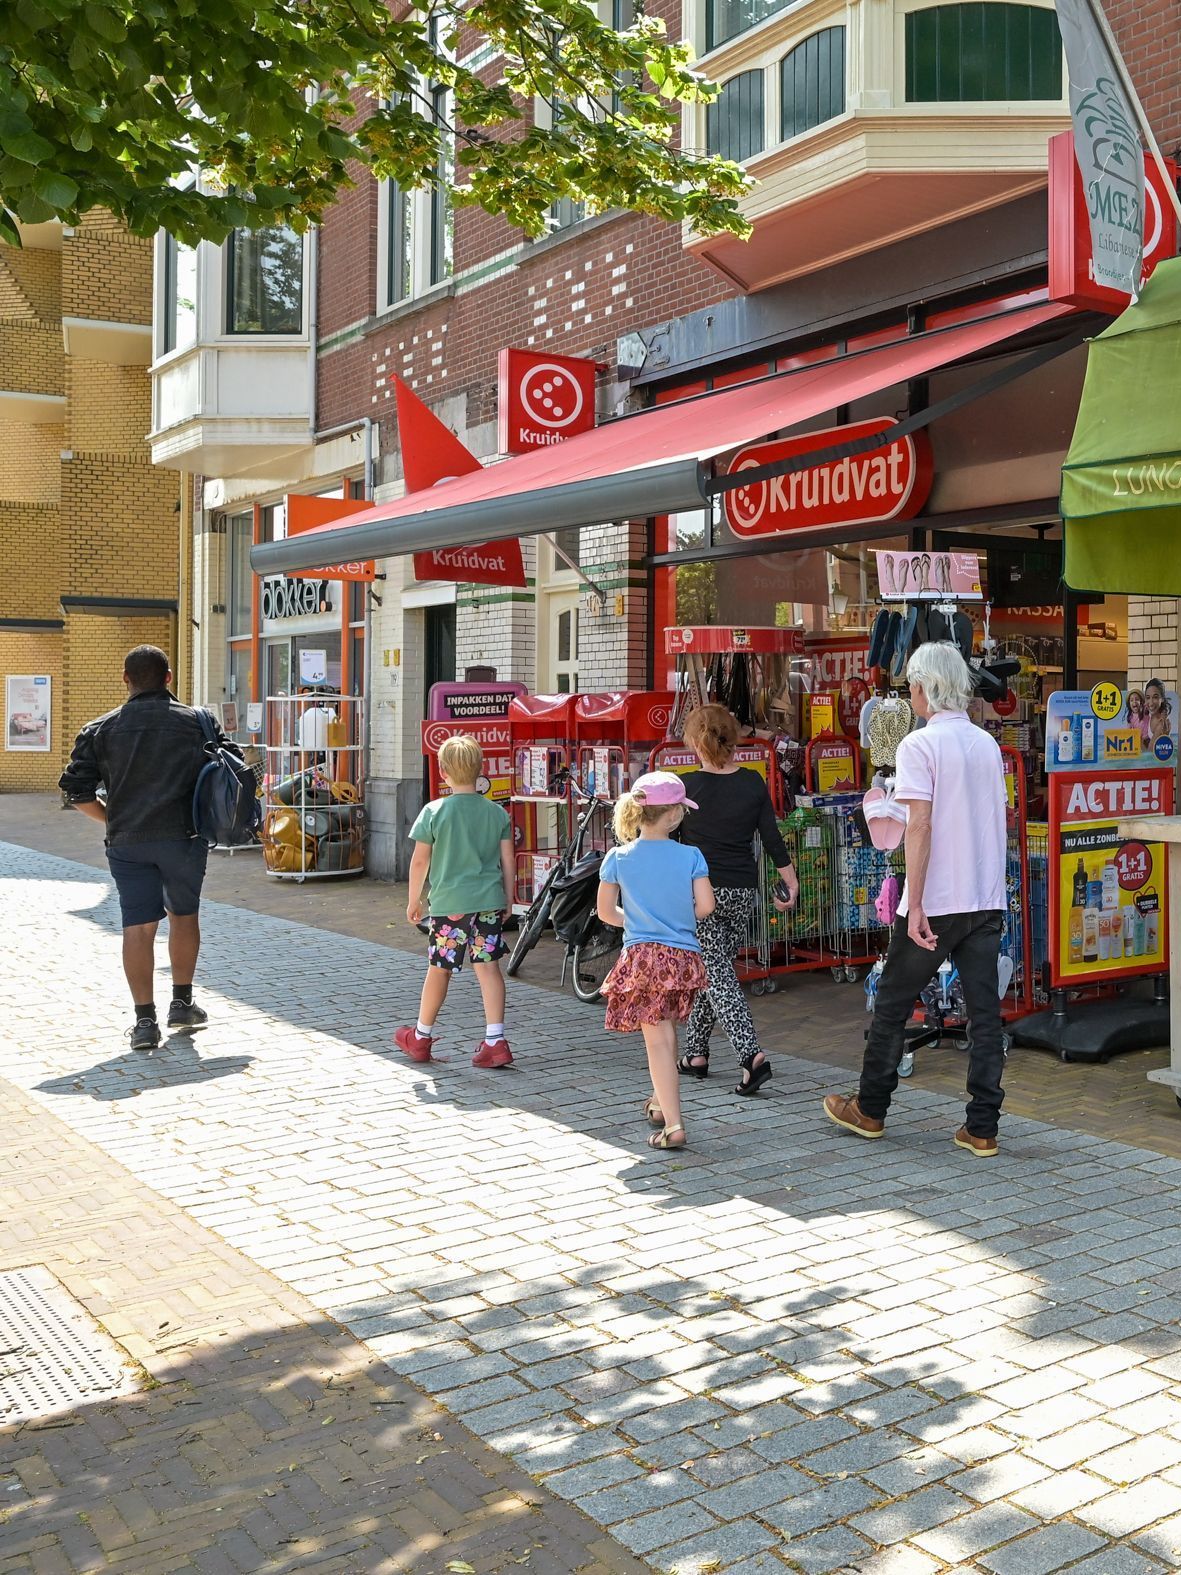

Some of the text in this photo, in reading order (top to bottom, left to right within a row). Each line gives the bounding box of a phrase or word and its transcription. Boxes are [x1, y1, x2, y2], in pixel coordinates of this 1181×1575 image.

[432, 550, 506, 571] Kruidvat
[811, 650, 870, 682] ACTIE!
[446, 694, 514, 705] INPAKKEN DAT
[812, 696, 831, 705] ACTIE!
[1095, 689, 1117, 706] 1+1
[454, 705, 505, 716] VOORDEEL!
[1106, 735, 1135, 753] Nr.1
[732, 751, 762, 761] ACTIE!
[821, 747, 850, 757] ACTIE!
[663, 754, 696, 766] ACTIE!
[1066, 780, 1160, 814] ACTIE!
[1065, 838, 1076, 848] NU
[1077, 836, 1095, 846] ALLE
[1118, 851, 1147, 874] 1+1
[1122, 871, 1144, 881] GRATIS
